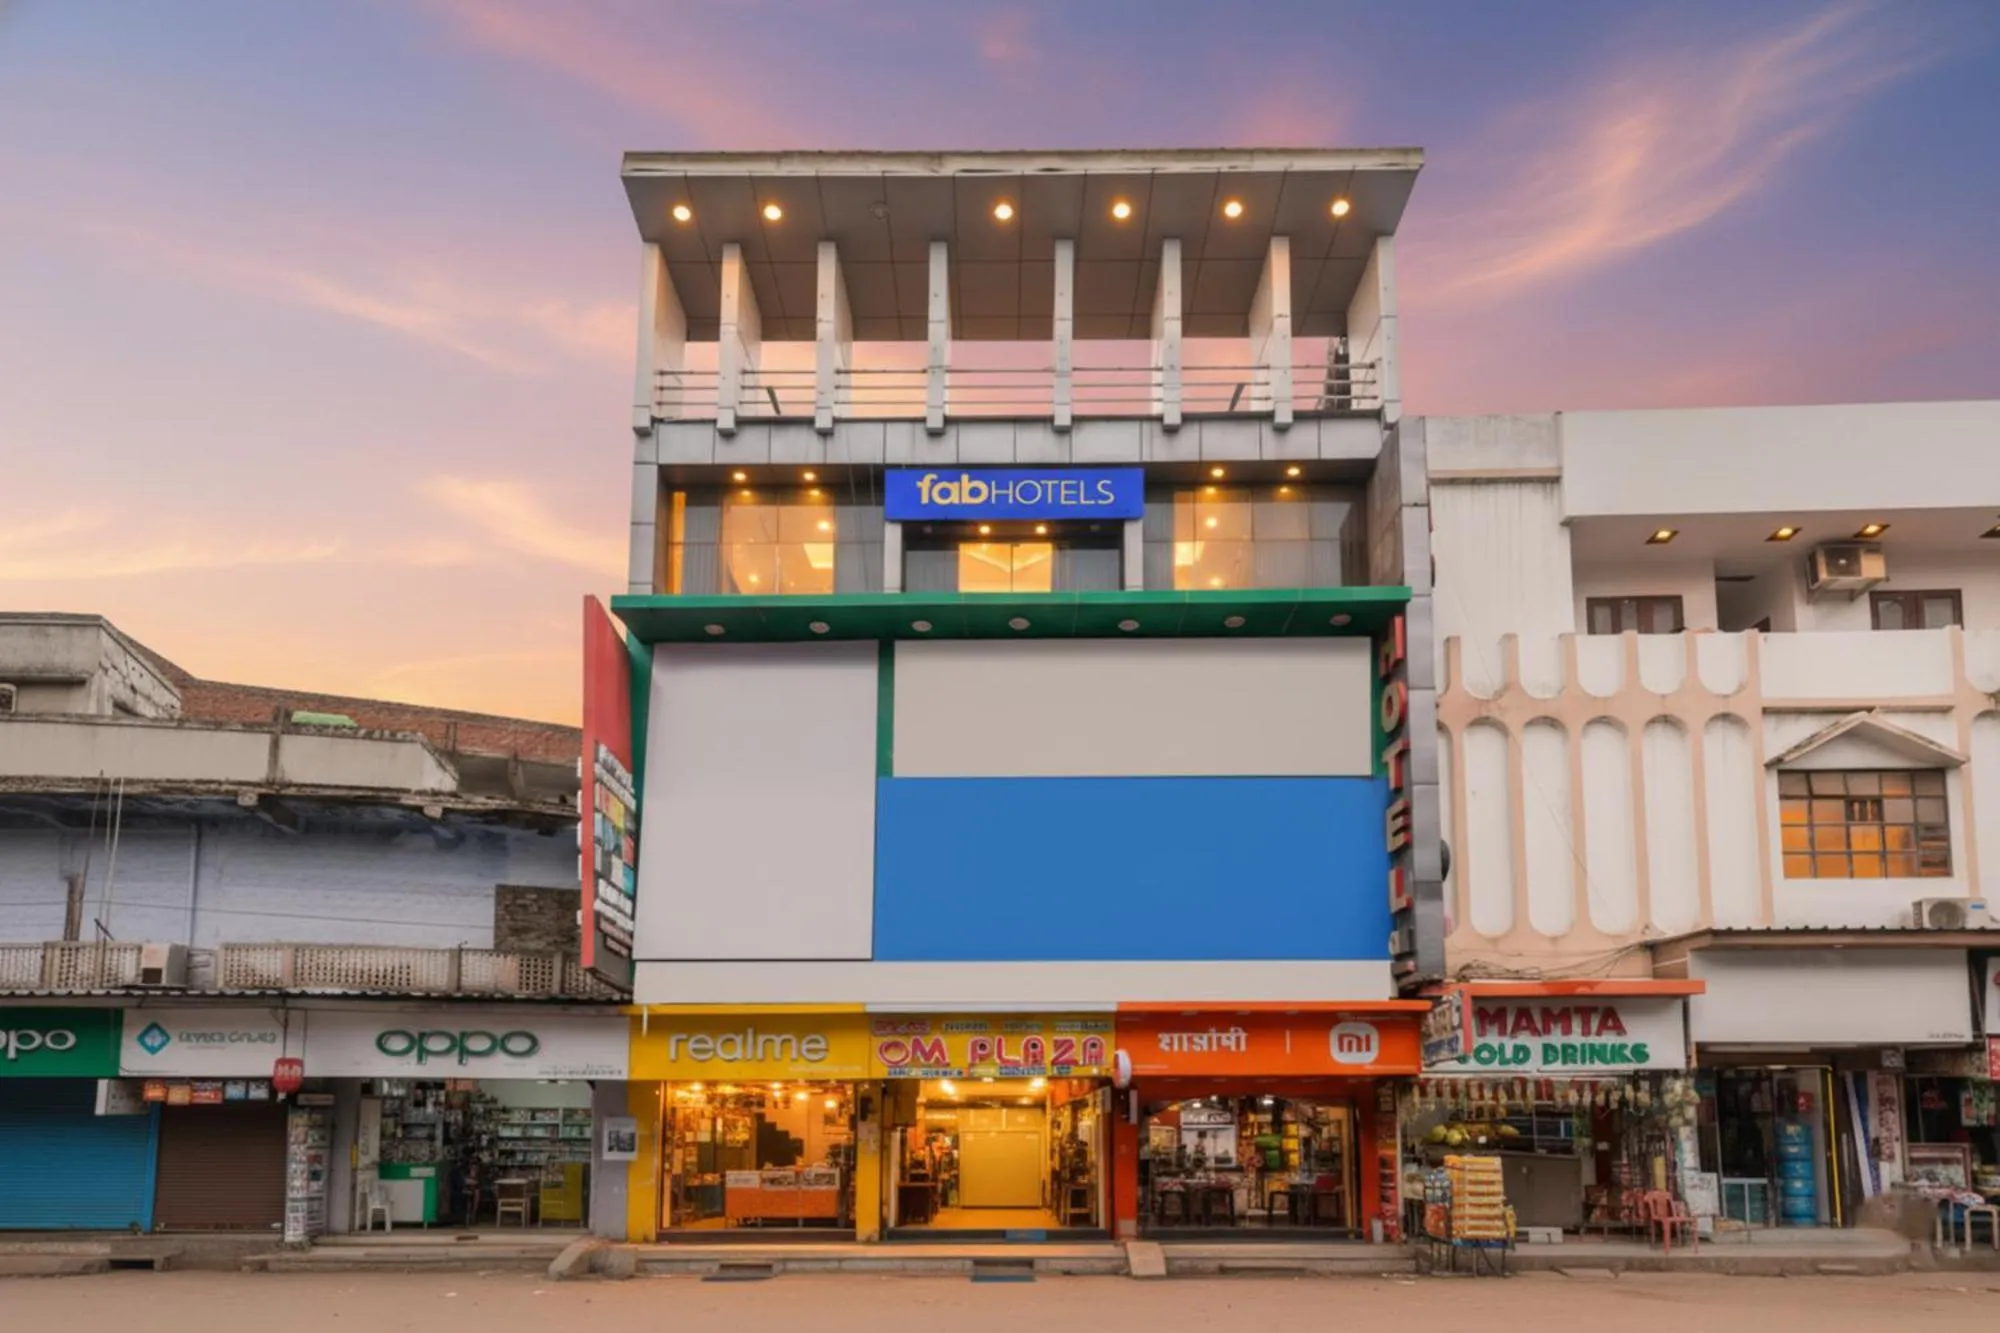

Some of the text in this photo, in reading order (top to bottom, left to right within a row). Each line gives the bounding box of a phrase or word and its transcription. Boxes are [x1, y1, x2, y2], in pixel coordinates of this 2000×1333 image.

[916, 473, 1115, 505] fabHOTELS
[1379, 614, 1412, 914] HOTEL
[1476, 1006, 1628, 1038] MAMTA
[0, 1029, 77, 1060] po
[376, 1029, 540, 1065] oppo
[669, 1027, 829, 1062] realme
[878, 1035, 1107, 1067] OM PLAZA
[1457, 1042, 1651, 1066] OLD DRINKS
